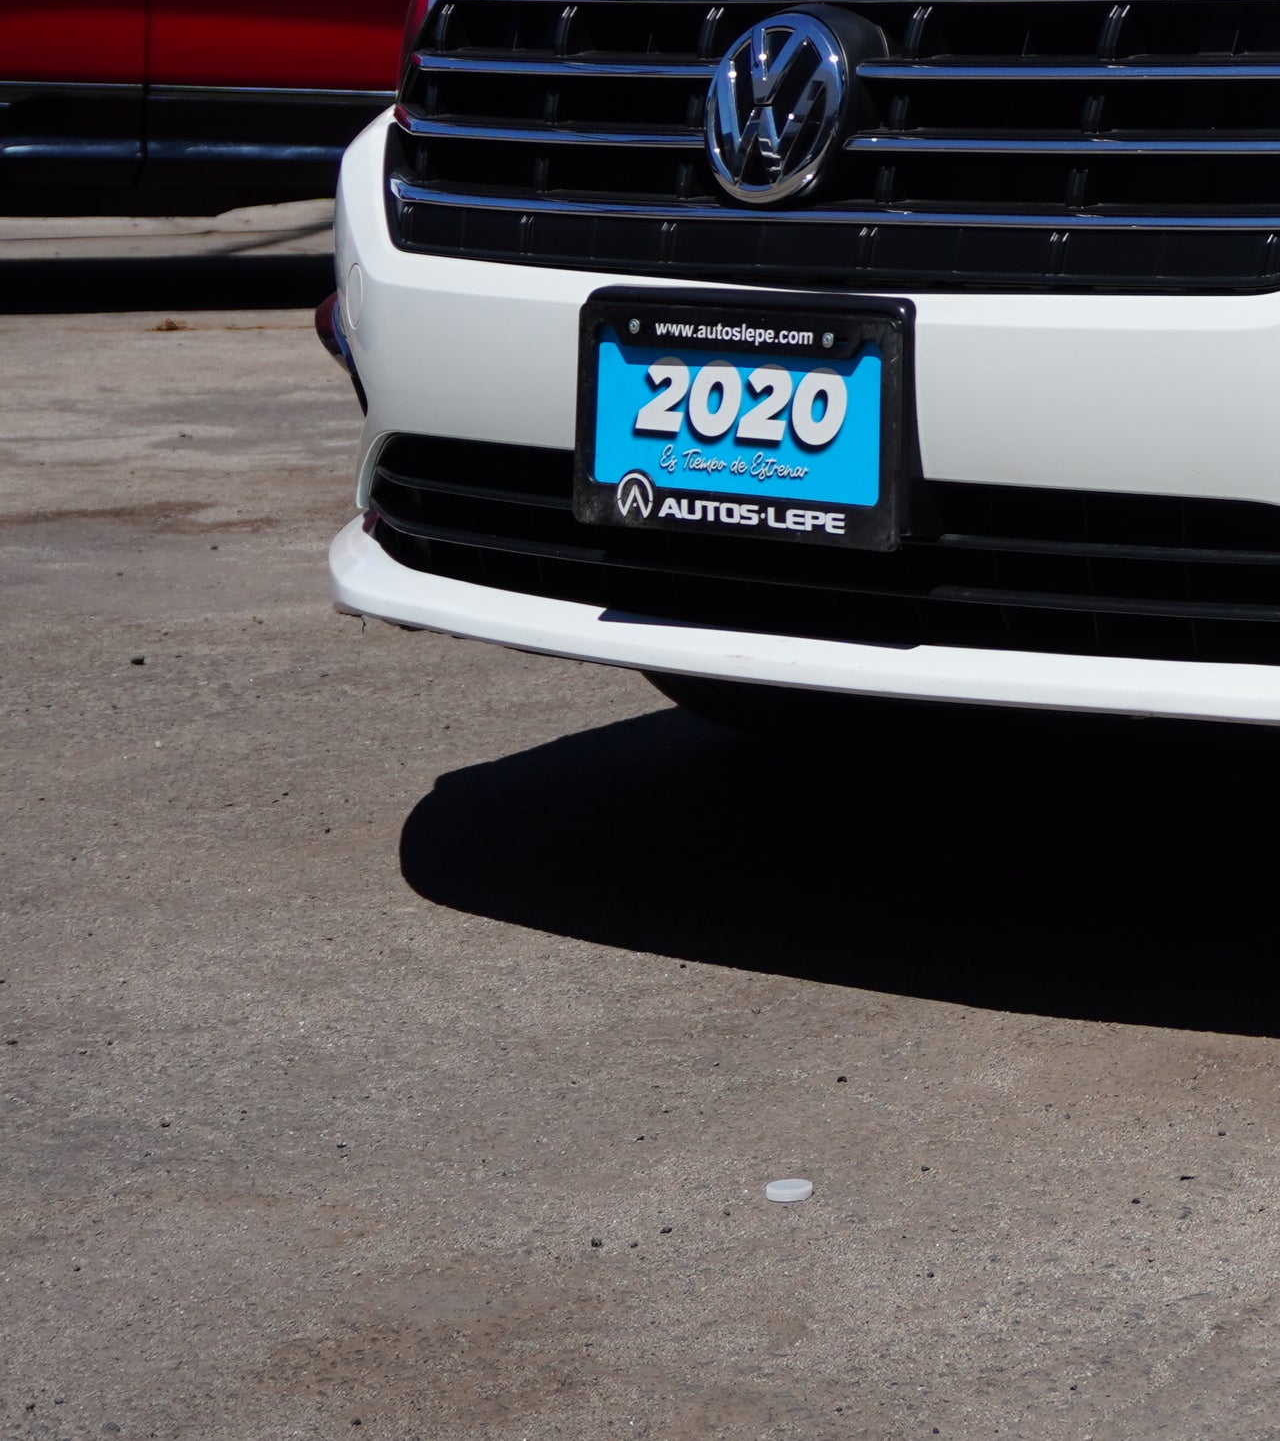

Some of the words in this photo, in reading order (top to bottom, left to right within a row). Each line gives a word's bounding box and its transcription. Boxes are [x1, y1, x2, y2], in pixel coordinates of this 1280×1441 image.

[655, 322, 814, 346] www.autoslepe.com
[635, 357, 848, 446] 2020
[660, 444, 677, 472] Es
[682, 448, 726, 473] Tiempo
[730, 456, 747, 475] de
[750, 452, 809, 480] Estrenar
